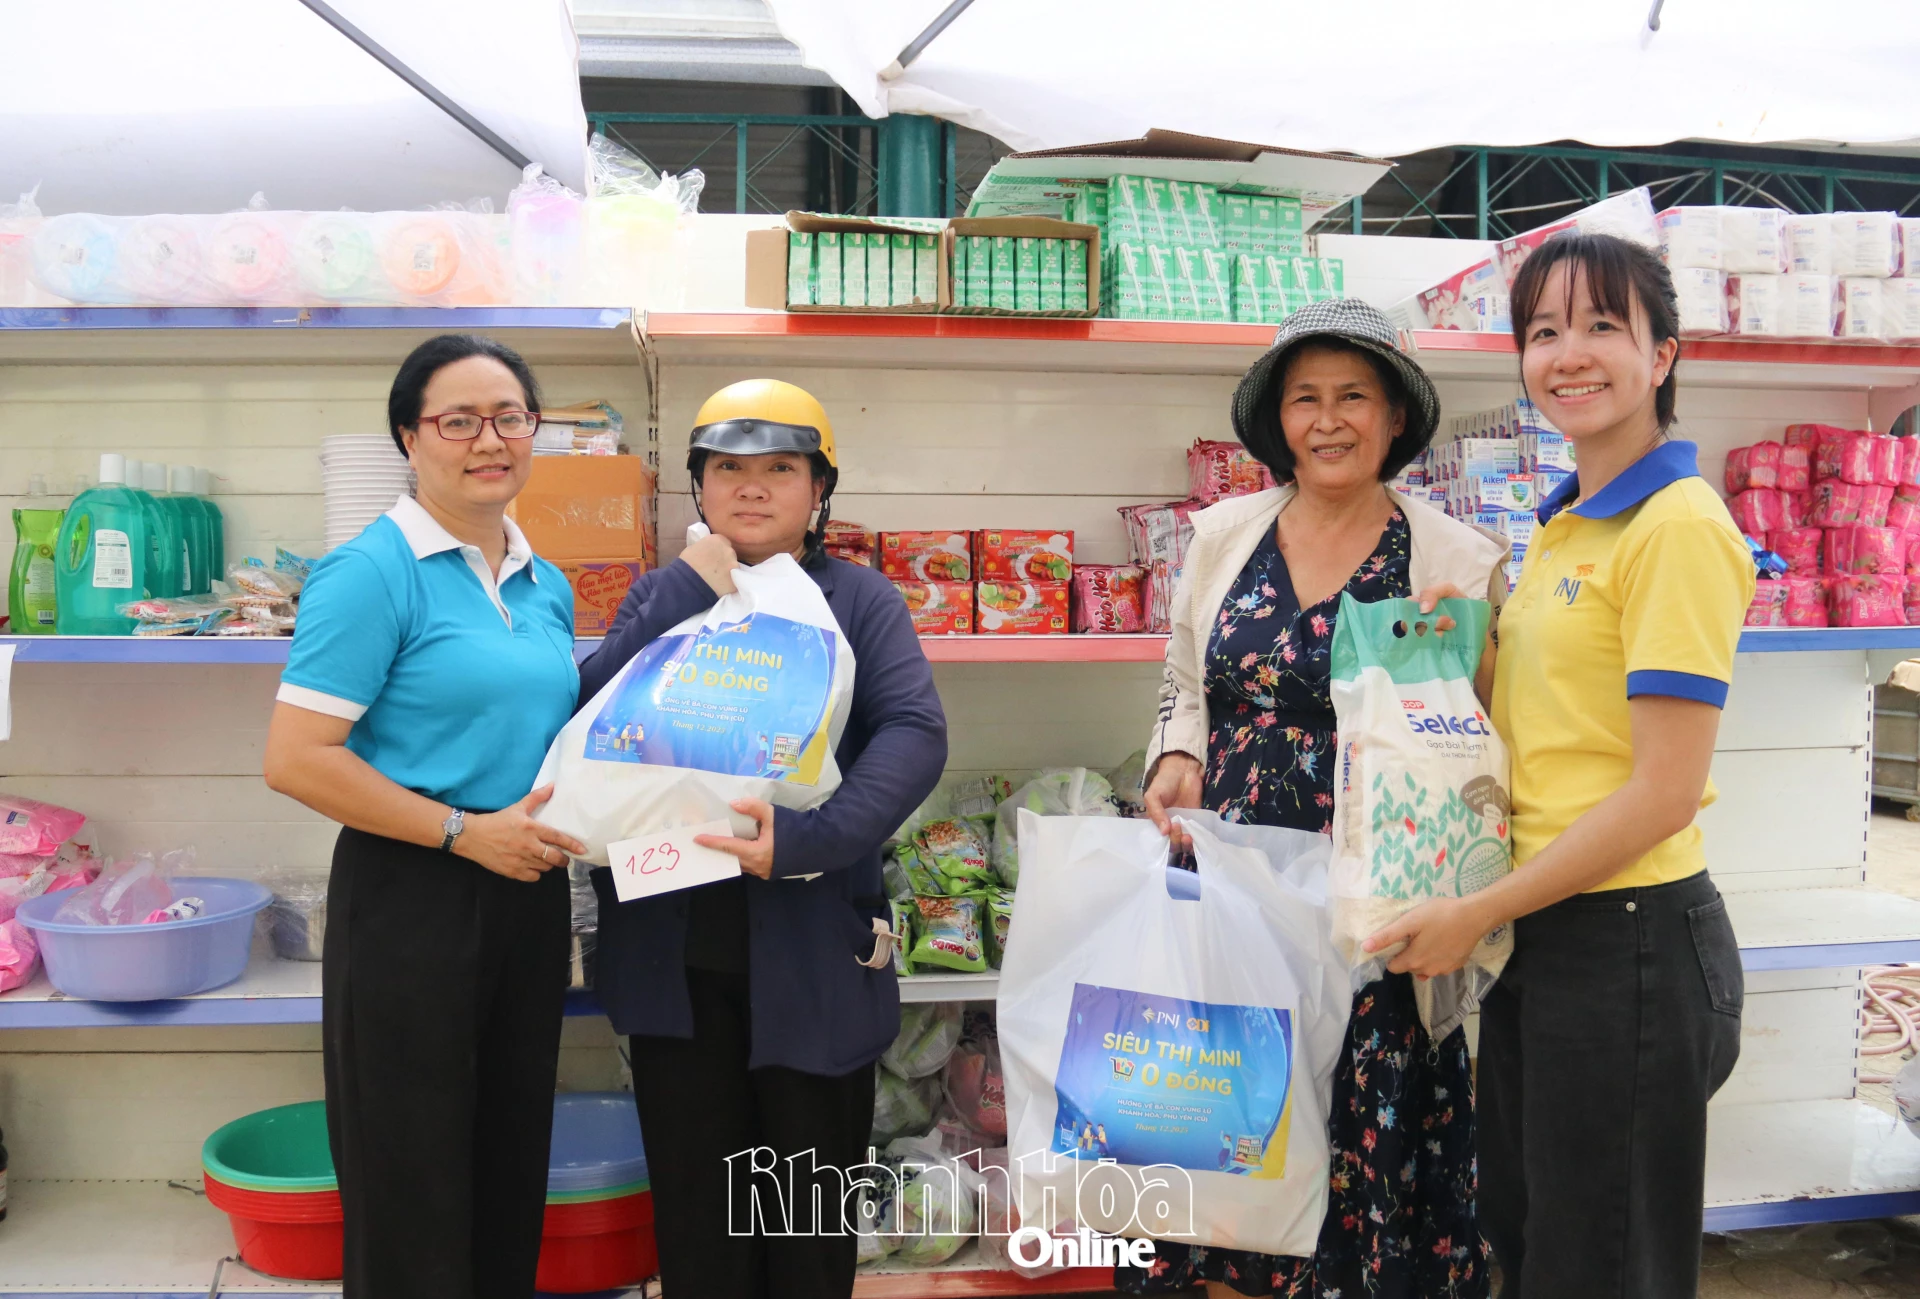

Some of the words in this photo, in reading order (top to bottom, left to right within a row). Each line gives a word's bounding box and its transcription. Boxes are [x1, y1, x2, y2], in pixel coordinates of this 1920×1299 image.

[1540, 436, 1564, 445] Aiken
[1482, 476, 1507, 485] Aiken
[1477, 516, 1498, 524] Aike
[1509, 514, 1534, 523] Aiken
[1088, 570, 1111, 599] Hảo
[1095, 600, 1117, 632] Hảo
[694, 643, 730, 666] THỊ
[735, 647, 783, 670] MINI
[678, 662, 698, 684] 0
[703, 667, 769, 693] ĐỒNG
[702, 703, 717, 711] CON
[1406, 710, 1491, 736] Select
[625, 842, 681, 875] 123
[1156, 1011, 1181, 1029] PNJ
[1102, 1031, 1150, 1055] SIÊU
[1156, 1041, 1193, 1067] THỊ
[1198, 1048, 1242, 1068] MINI
[1141, 1062, 1160, 1087] 0
[1165, 1069, 1233, 1096] ĐỒNG
